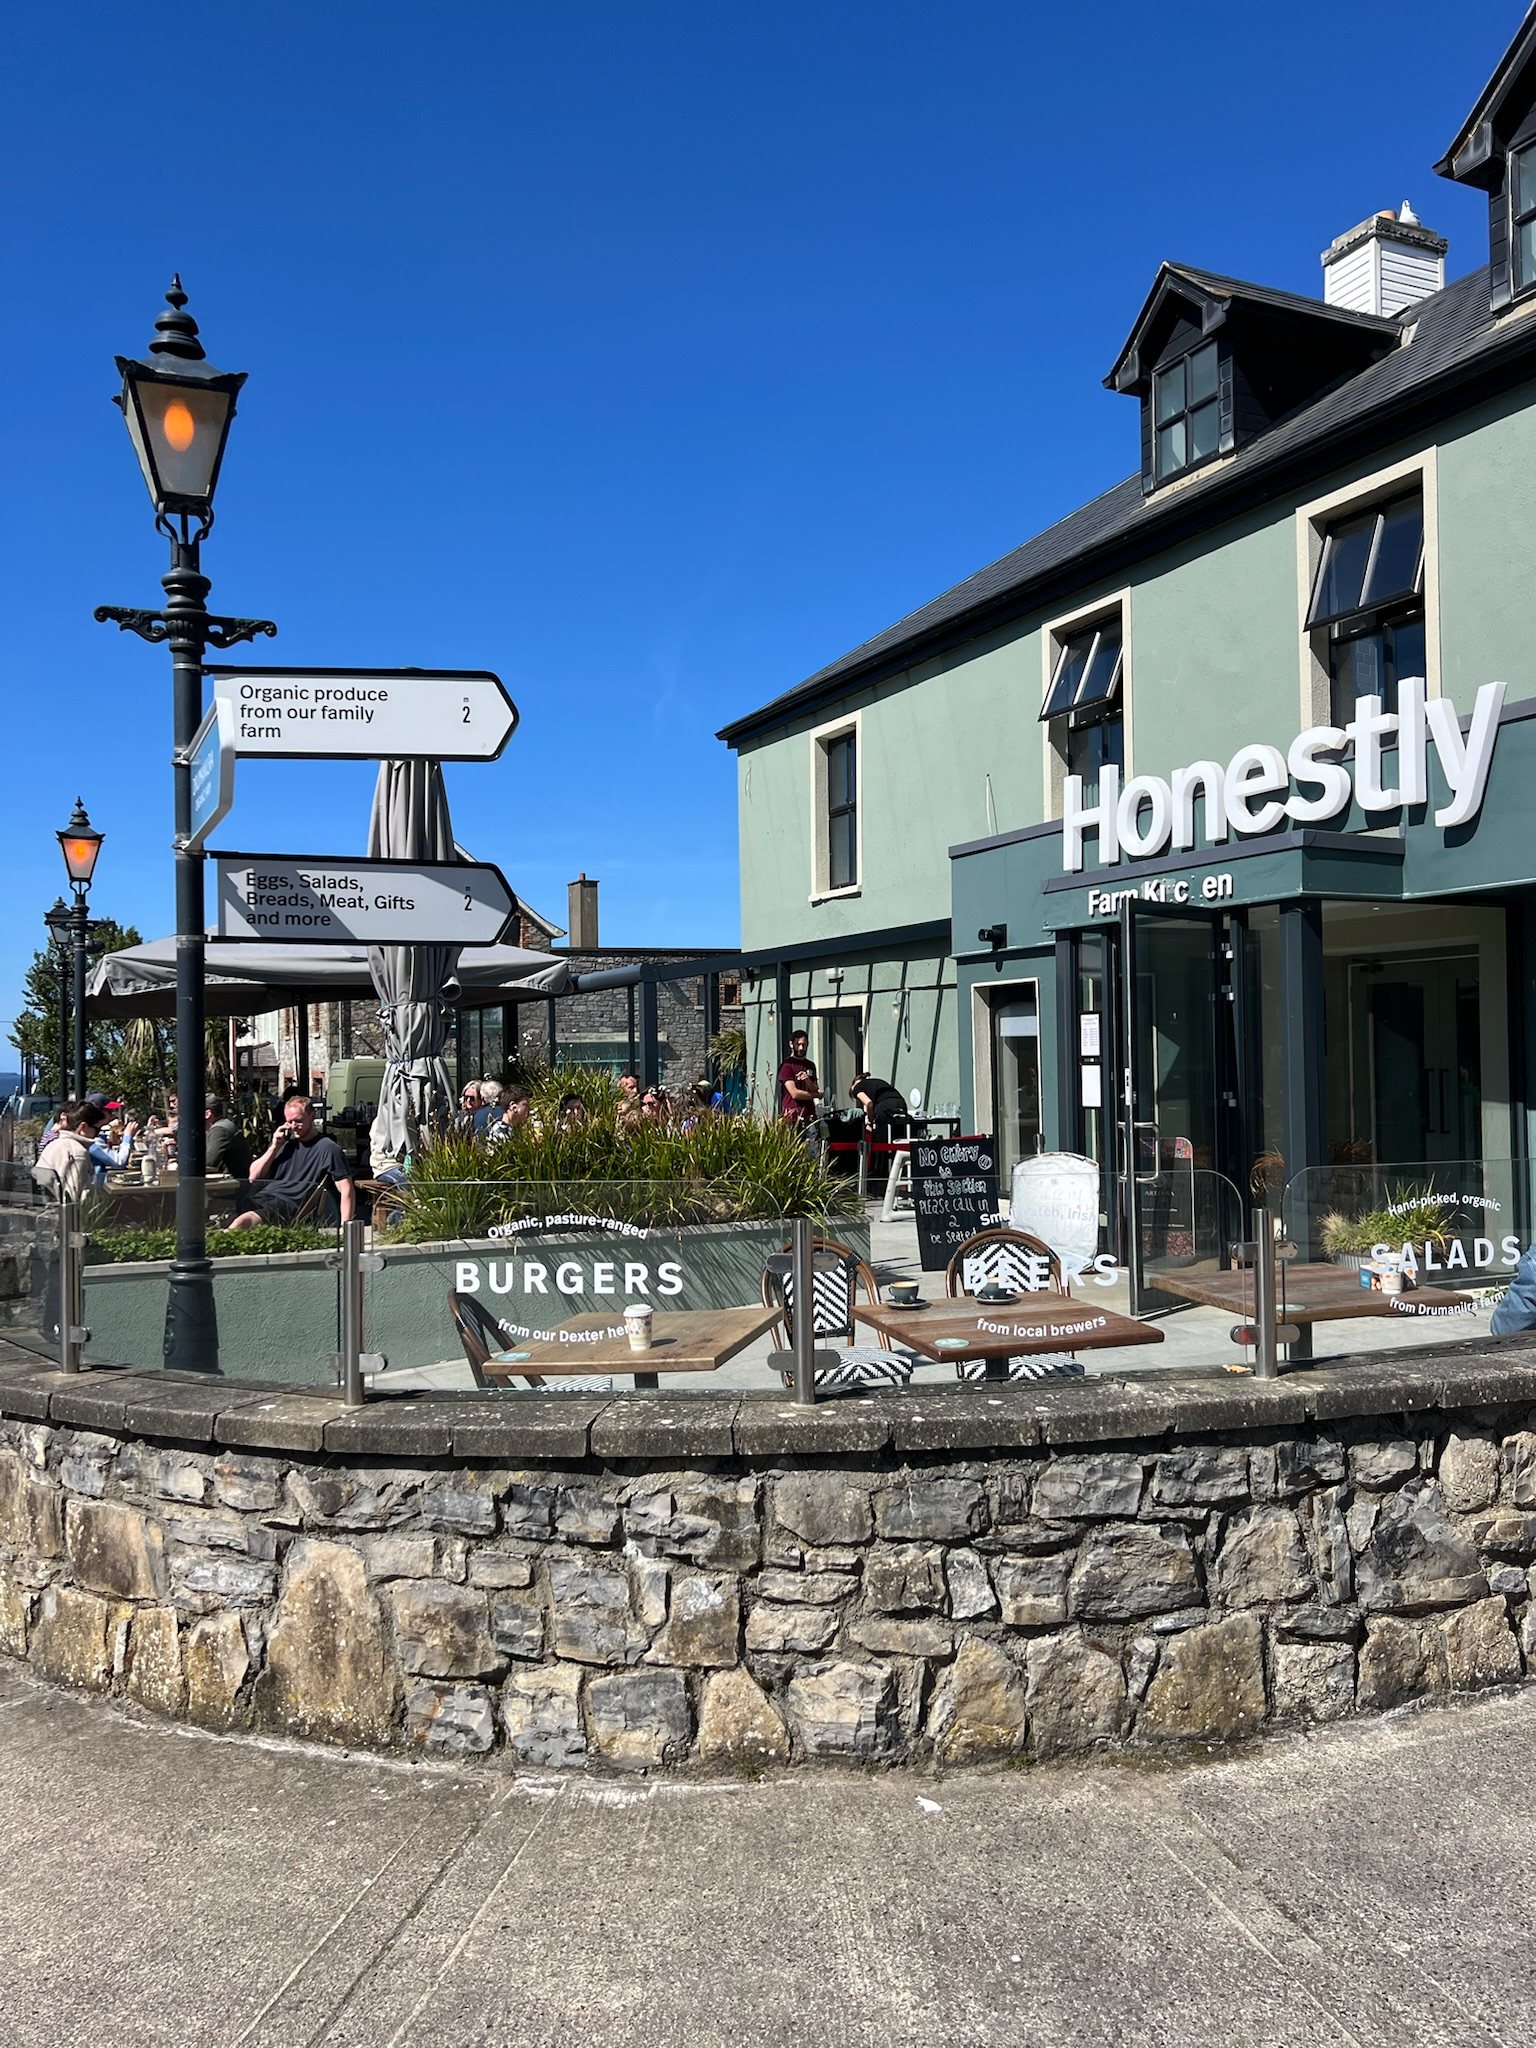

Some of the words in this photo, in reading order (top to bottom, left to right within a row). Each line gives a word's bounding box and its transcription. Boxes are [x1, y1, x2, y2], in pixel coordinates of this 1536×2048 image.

[240, 684, 309, 702] Organic
[314, 686, 388, 702] produce
[240, 703, 282, 719] from
[287, 707, 318, 720] our
[321, 705, 375, 723] family
[462, 705, 471, 723] 2
[240, 723, 281, 738] farm
[1063, 676, 1507, 871] Honestly
[246, 872, 294, 890] Eggs,
[299, 874, 364, 892] Salads,
[246, 892, 315, 909] Breads,
[319, 894, 369, 911] Meat,
[374, 894, 415, 910] Gifts
[464, 894, 472, 911] 2
[1088, 888, 1139, 916] Farm
[246, 911, 280, 925] and
[285, 914, 331, 926] more
[923, 1179, 945, 1196] this
[1387, 1192, 1459, 1217] Hand-picked,
[1462, 1194, 1502, 1212] organic
[487, 1214, 543, 1239] Organic,
[545, 1211, 649, 1240] pasture-ranged
[1371, 1235, 1522, 1272] SALADS
[455, 1261, 684, 1295] BURGERS
[963, 1254, 1119, 1290] BEERS
[1389, 1296, 1416, 1314] from
[1480, 1291, 1505, 1309] farm
[497, 1318, 530, 1338] from
[533, 1330, 557, 1342] our
[559, 1329, 605, 1342] Dexter
[976, 1317, 1010, 1336] from
[1013, 1320, 1047, 1337] local
[1050, 1313, 1107, 1336] brewers
